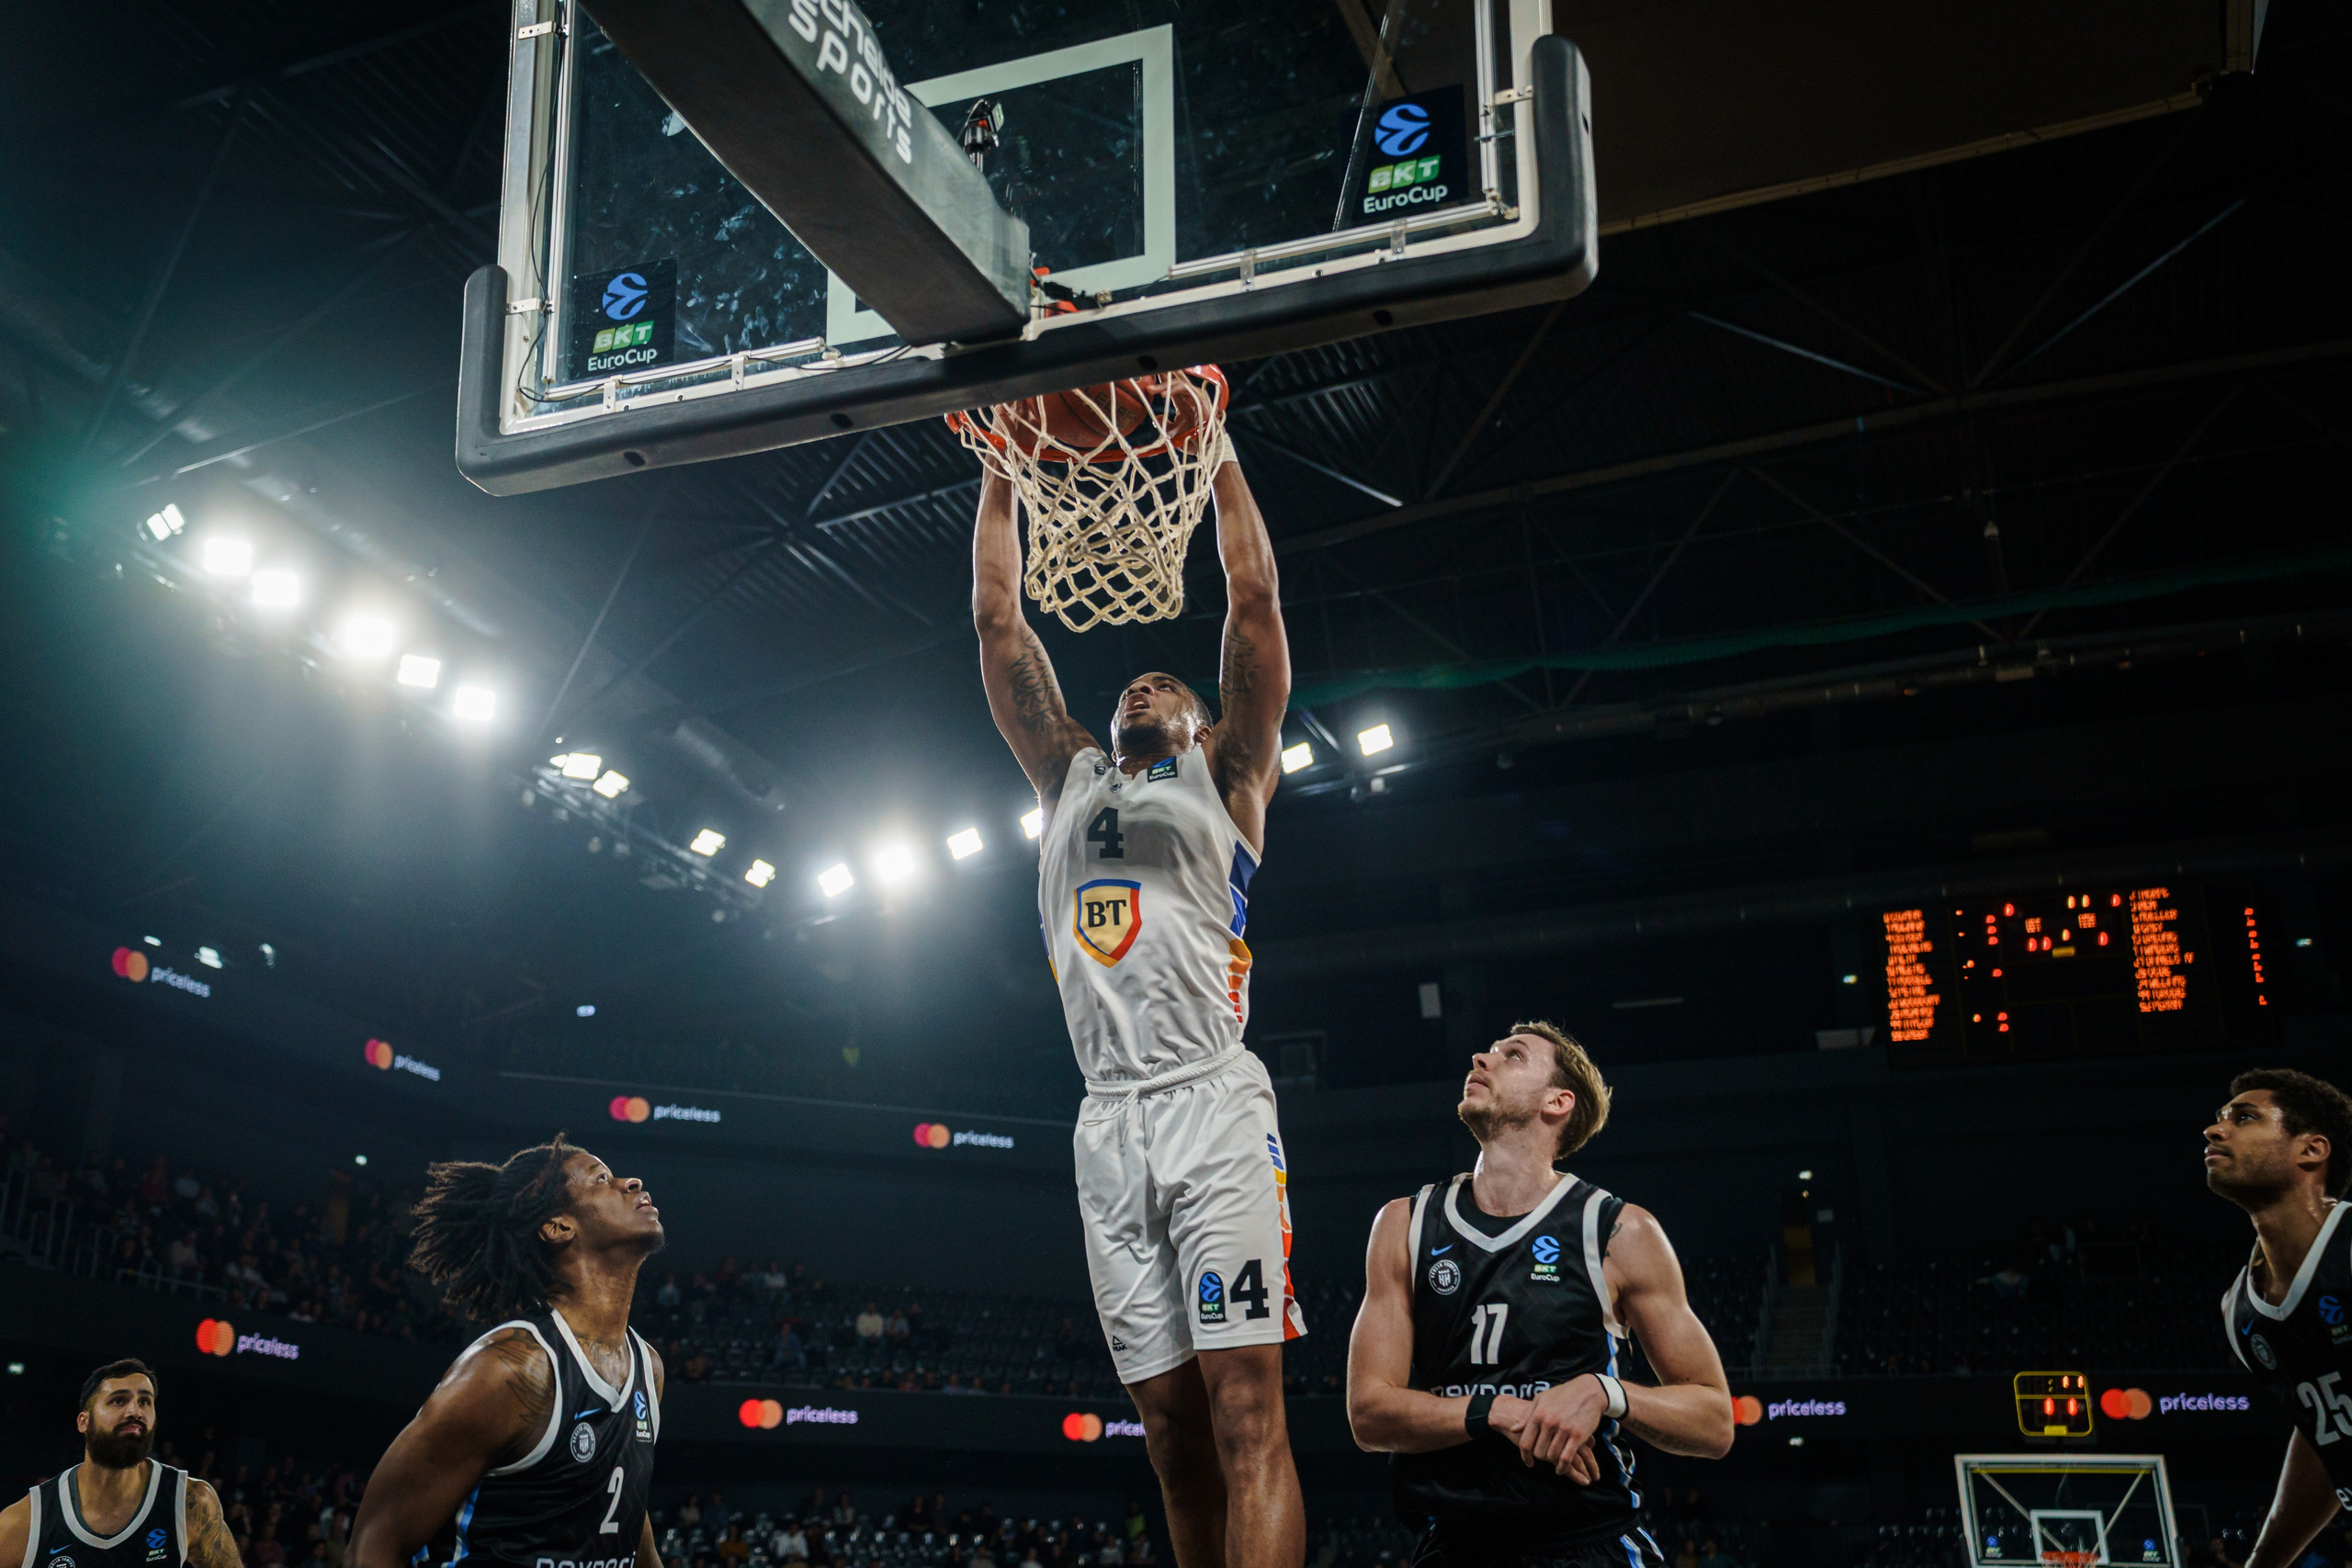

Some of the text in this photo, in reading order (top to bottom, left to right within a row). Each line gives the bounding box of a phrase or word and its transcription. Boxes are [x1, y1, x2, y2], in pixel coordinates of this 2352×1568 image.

[812, 0, 911, 129] chelde
[1369, 157, 1440, 191] BKT
[1363, 184, 1448, 214] EuroCup
[595, 323, 653, 351] BKT
[588, 348, 658, 372] EuroCup
[1148, 771, 1176, 781] EuroCup
[1087, 806, 1125, 860] 4
[1085, 899, 1127, 929] BT
[151, 966, 211, 998] priceless
[394, 1055, 441, 1082] priceless
[653, 1103, 721, 1123] priceless
[953, 1129, 1015, 1149] priceless
[1228, 1258, 1270, 1321] 4
[1531, 1272, 1561, 1283] EuroCup
[1200, 1312, 1224, 1321] EuroCup
[236, 1332, 300, 1360] priceless
[1471, 1303, 1509, 1365] 17
[786, 1404, 859, 1426] priceless
[1768, 1398, 1847, 1421] priceless
[2159, 1391, 2251, 1415] priceless
[2297, 1371, 2352, 1446] 25
[599, 1466, 624, 1534] 2
